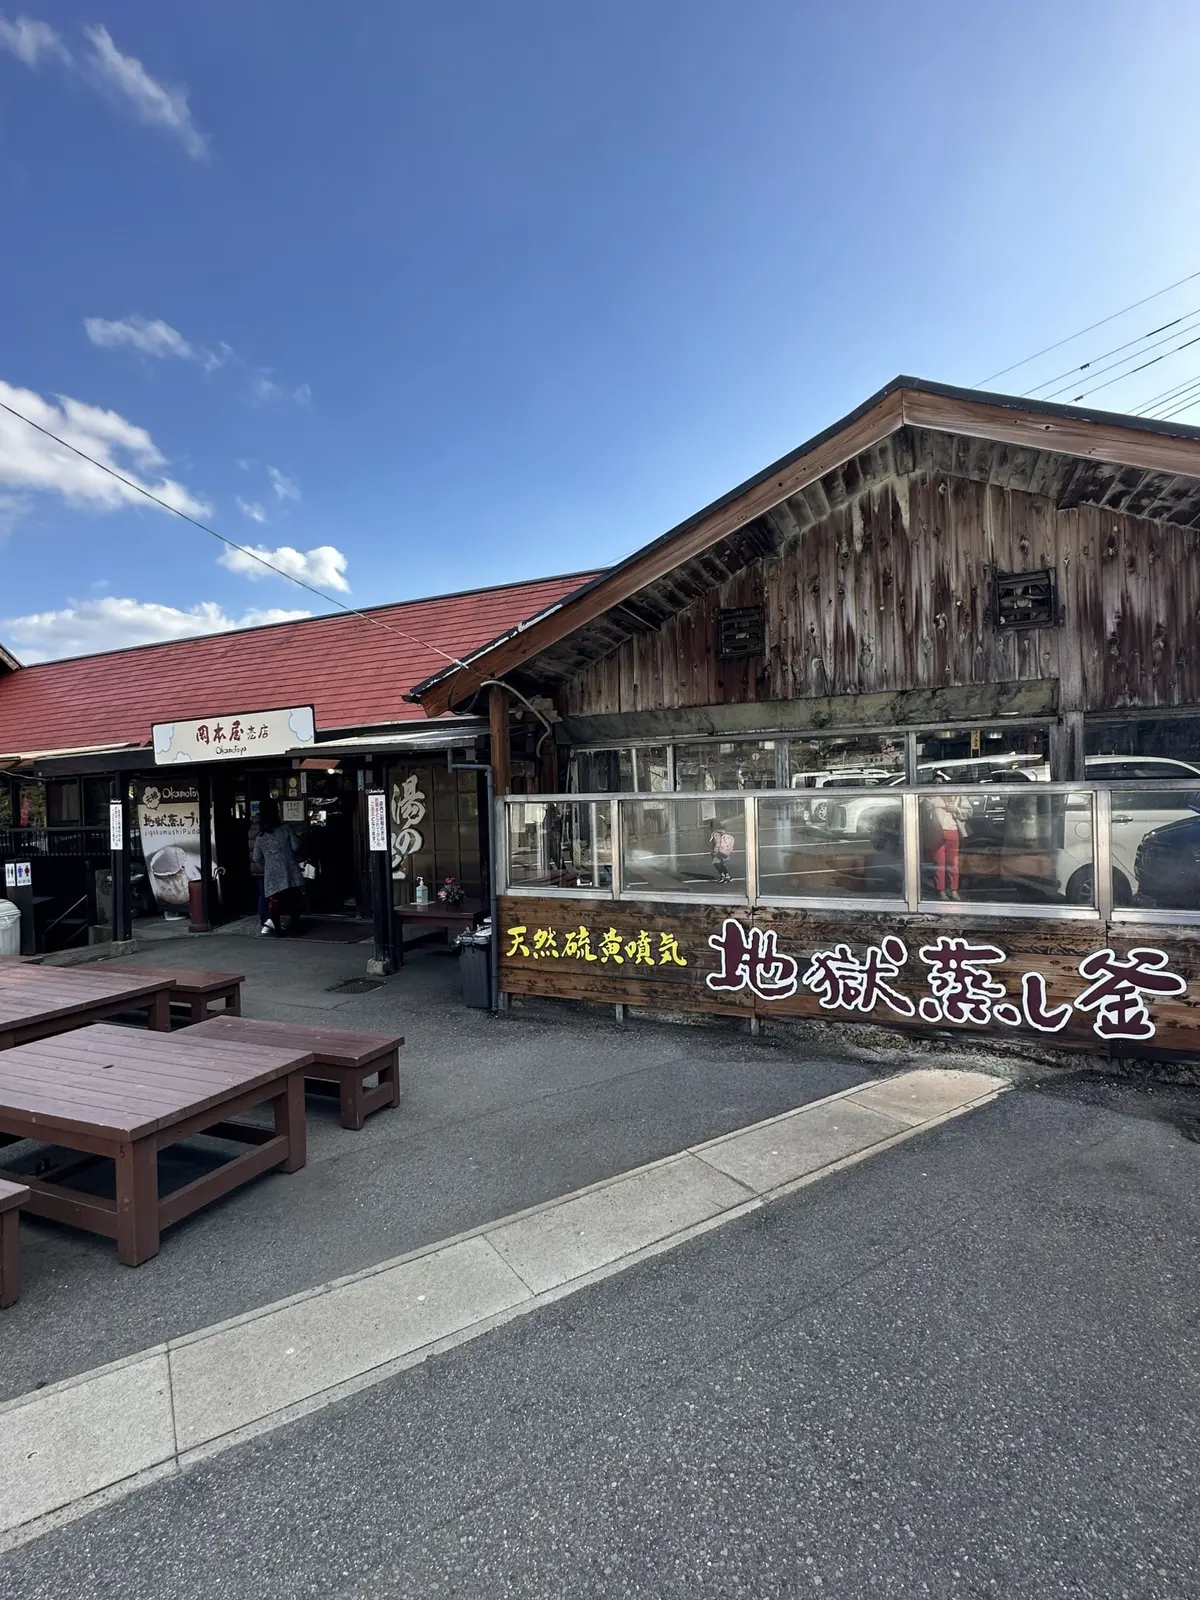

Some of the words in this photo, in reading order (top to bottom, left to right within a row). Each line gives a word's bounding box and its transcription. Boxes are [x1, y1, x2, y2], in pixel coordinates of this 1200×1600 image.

[506, 925, 687, 967] 天然硫黄噴気
[706, 918, 1187, 1040] 地獄蒸し釜
